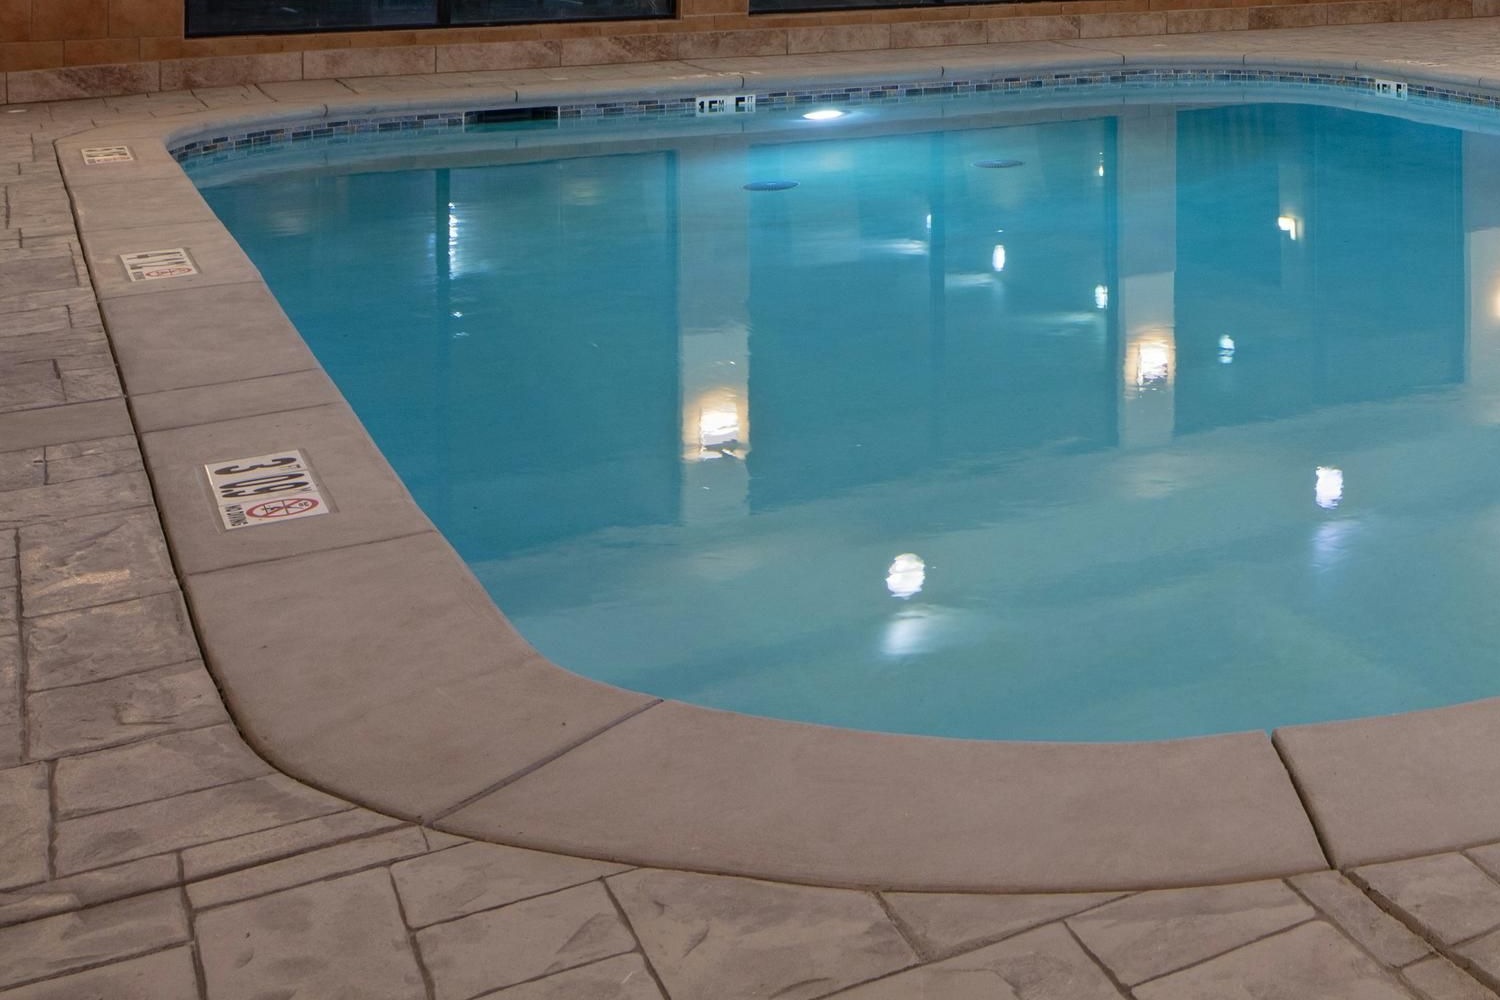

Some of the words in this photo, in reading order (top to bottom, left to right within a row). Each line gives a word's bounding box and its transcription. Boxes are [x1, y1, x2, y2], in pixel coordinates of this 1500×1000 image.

[214, 457, 297, 475] 3
[219, 473, 309, 498] 0.9
[227, 511, 248, 526] DIVING
